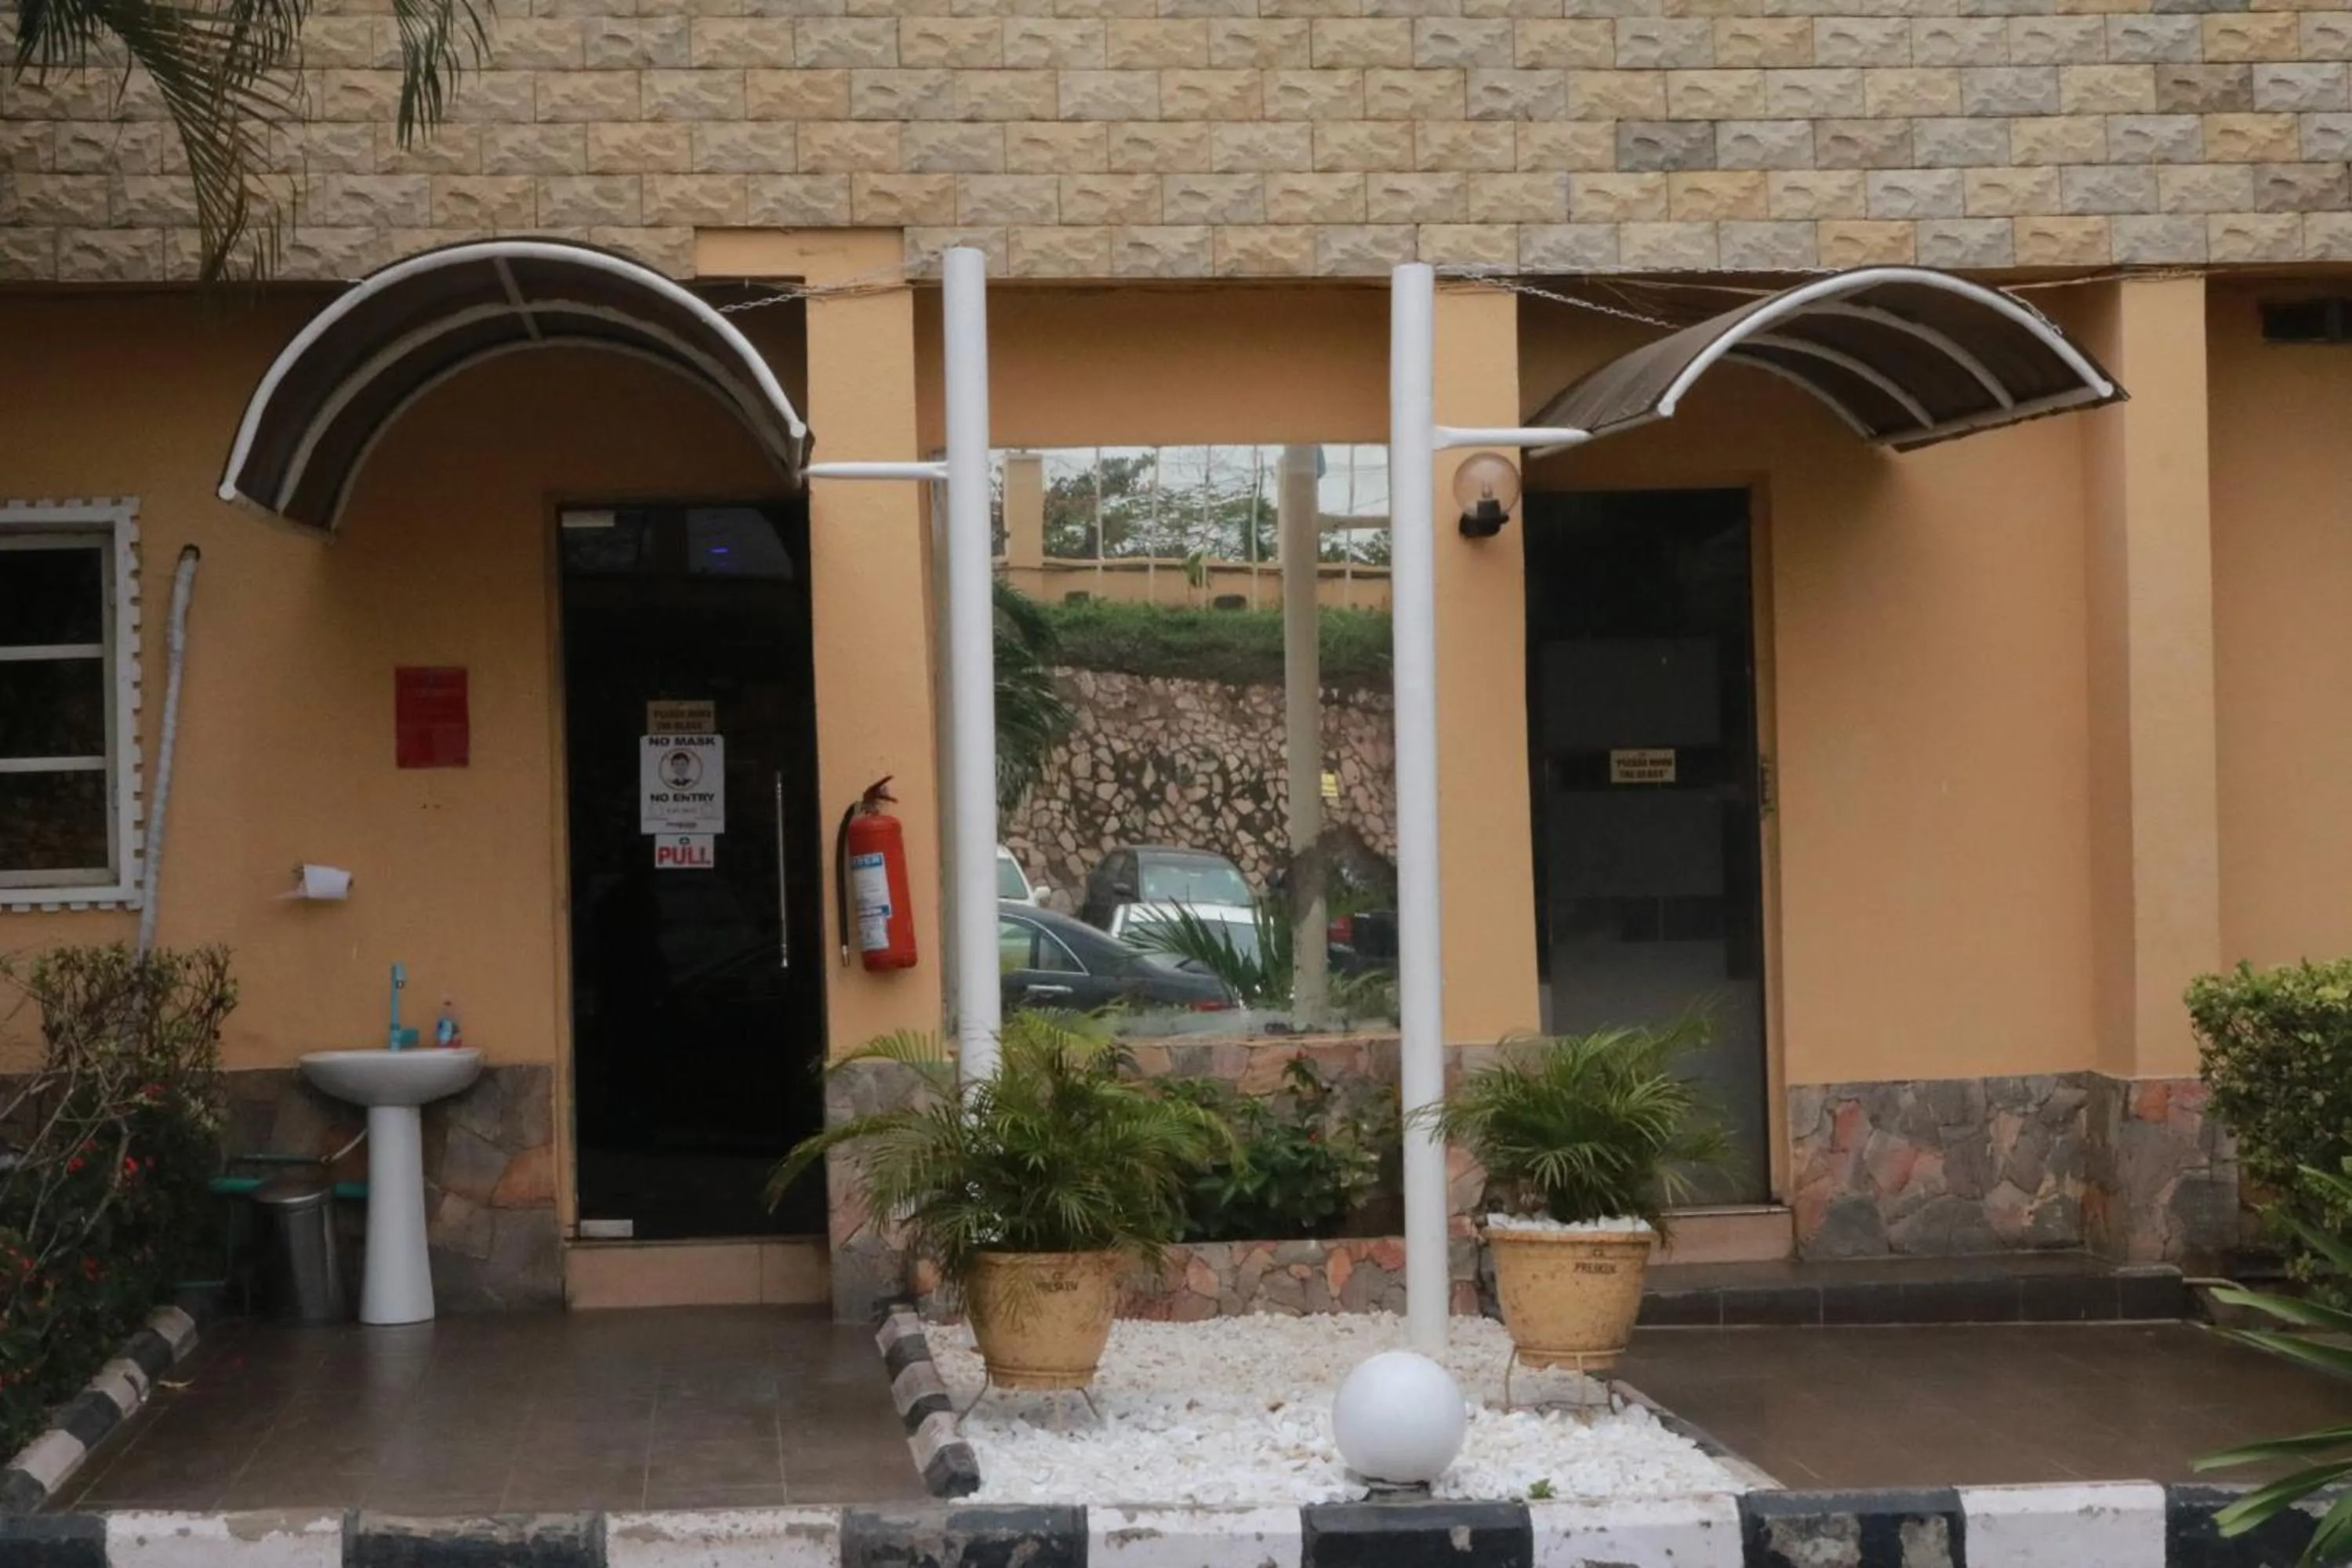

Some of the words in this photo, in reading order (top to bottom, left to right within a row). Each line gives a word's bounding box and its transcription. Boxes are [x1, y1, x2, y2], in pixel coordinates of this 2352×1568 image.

[648, 737, 670, 746] NO
[675, 737, 715, 746] MASK
[650, 793, 669, 802] NO
[673, 793, 715, 802] ENTRY
[658, 847, 711, 865] PULL
